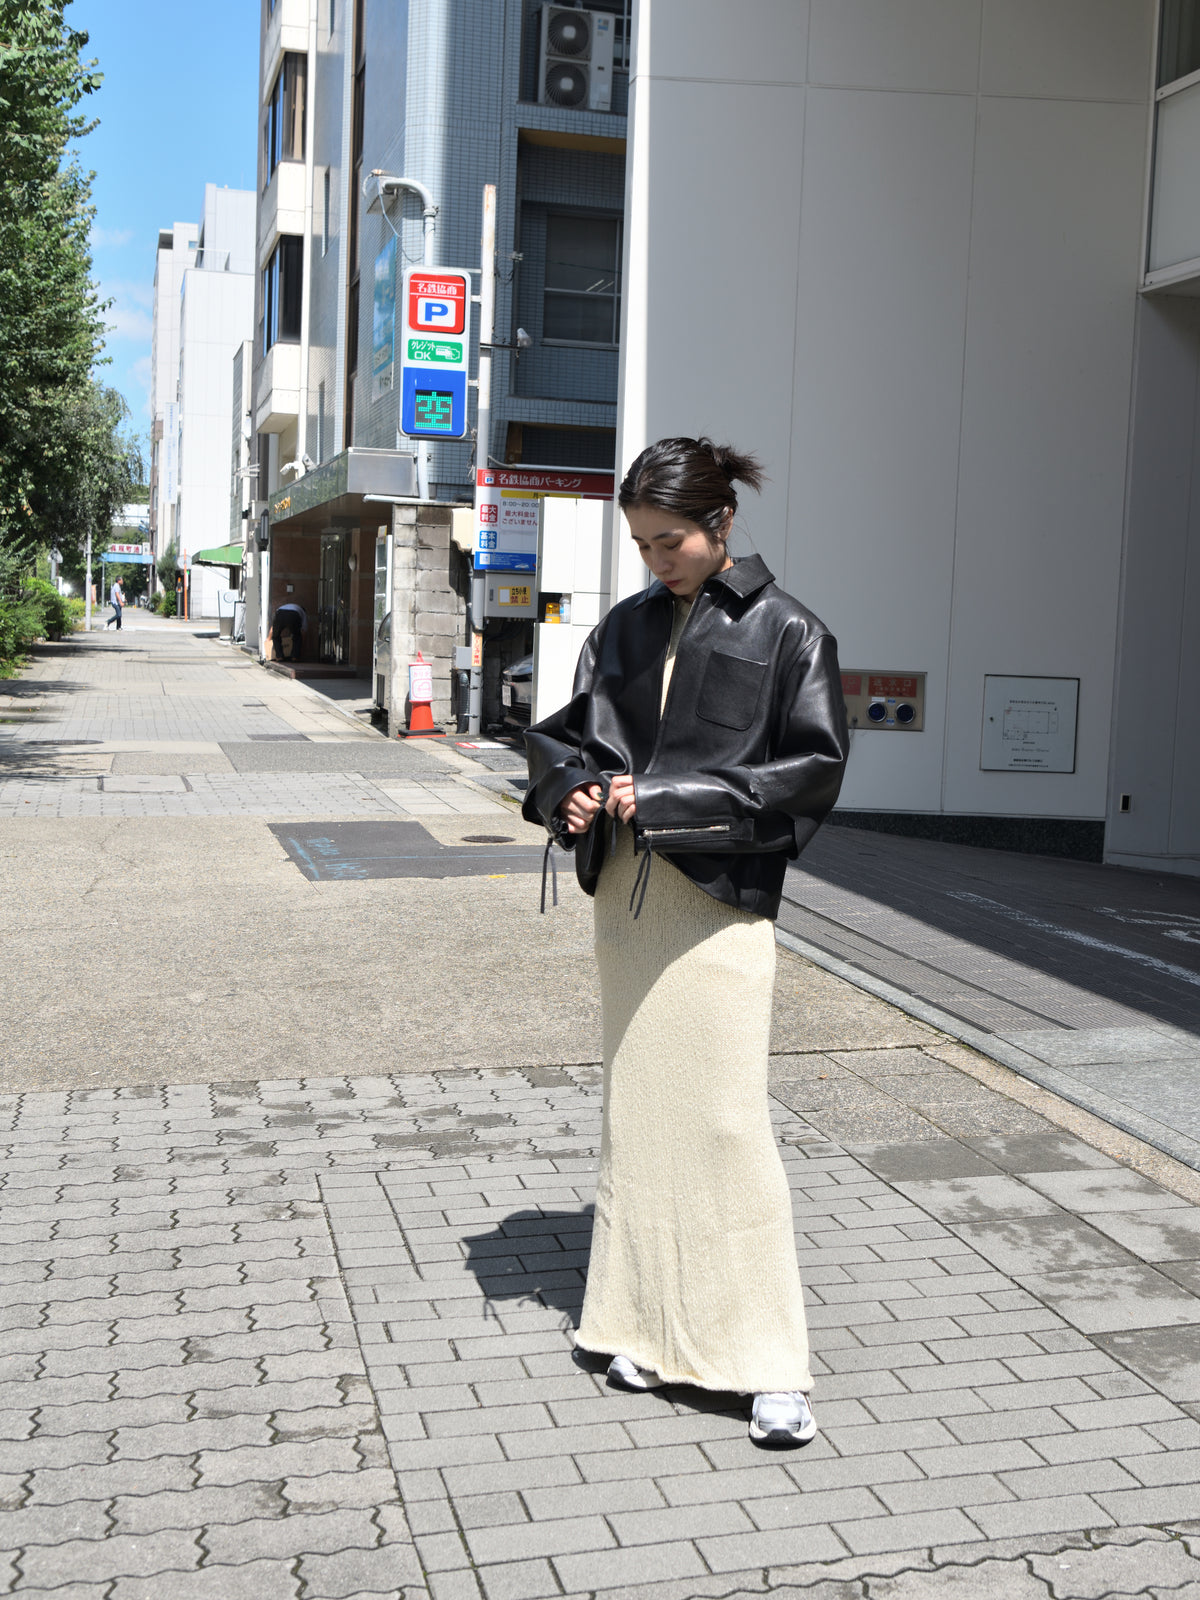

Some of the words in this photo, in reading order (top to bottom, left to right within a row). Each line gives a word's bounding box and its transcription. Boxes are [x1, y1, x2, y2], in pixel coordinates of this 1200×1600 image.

[417, 282, 457, 296] 名鉄協商
[425, 302, 449, 322] P
[411, 340, 436, 351] クレジット
[414, 351, 431, 360] OK
[415, 391, 453, 429] 空
[499, 473, 582, 488] 名鉄協商パーキング
[505, 510, 536, 518] 最大料金は
[502, 518, 538, 526] ございません
[511, 595, 529, 604] 禁止
